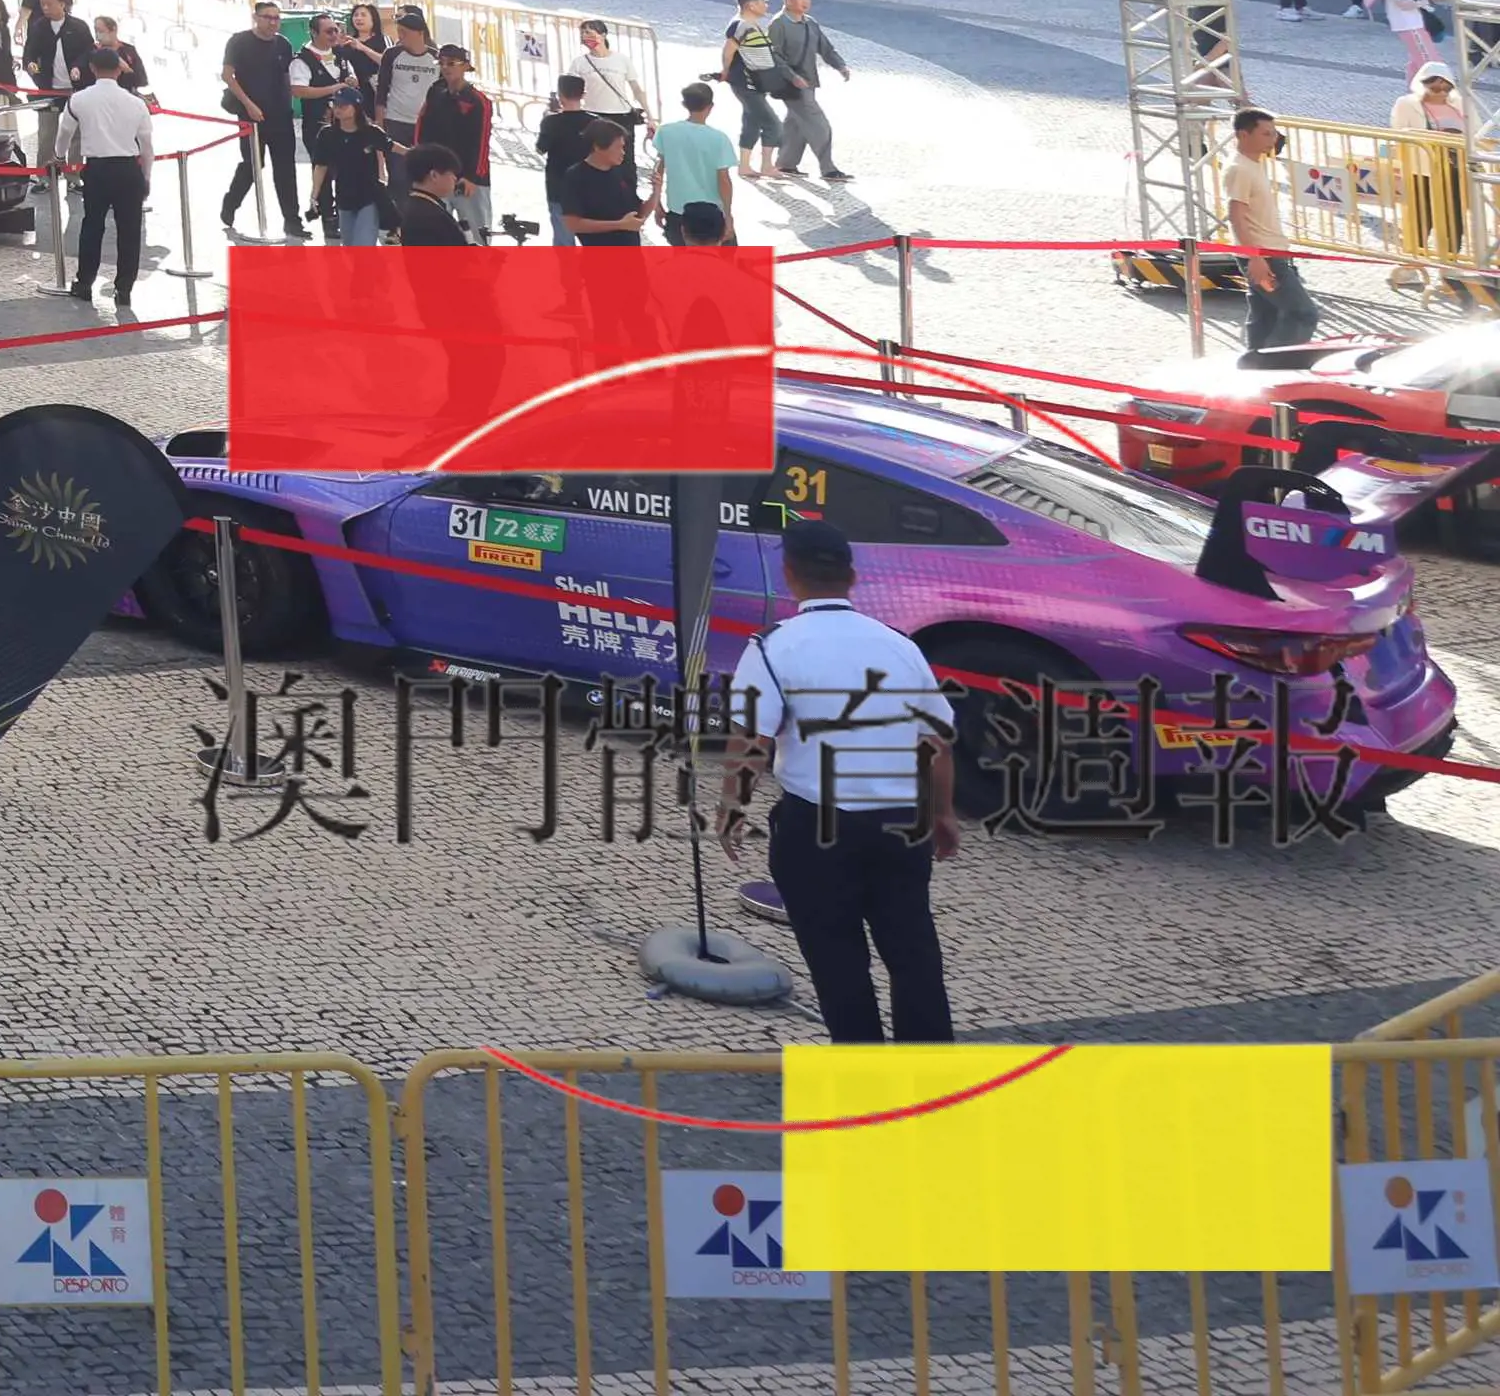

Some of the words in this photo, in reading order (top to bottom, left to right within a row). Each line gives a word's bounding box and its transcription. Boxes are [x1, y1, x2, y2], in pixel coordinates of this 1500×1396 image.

[785, 466, 826, 505] 31
[8, 493, 101, 531] 金沙中國
[587, 490, 628, 516] VAN
[42, 525, 86, 545] China
[451, 506, 483, 542] 31
[493, 520, 518, 542] 72
[1246, 516, 1311, 544] GEN
[474, 544, 534, 568] PIRELLI
[555, 576, 609, 599] Shell
[561, 626, 623, 655] 壳牌
[53, 1276, 129, 1294] DESPORTO
[732, 1270, 806, 1287] DESPORTO
